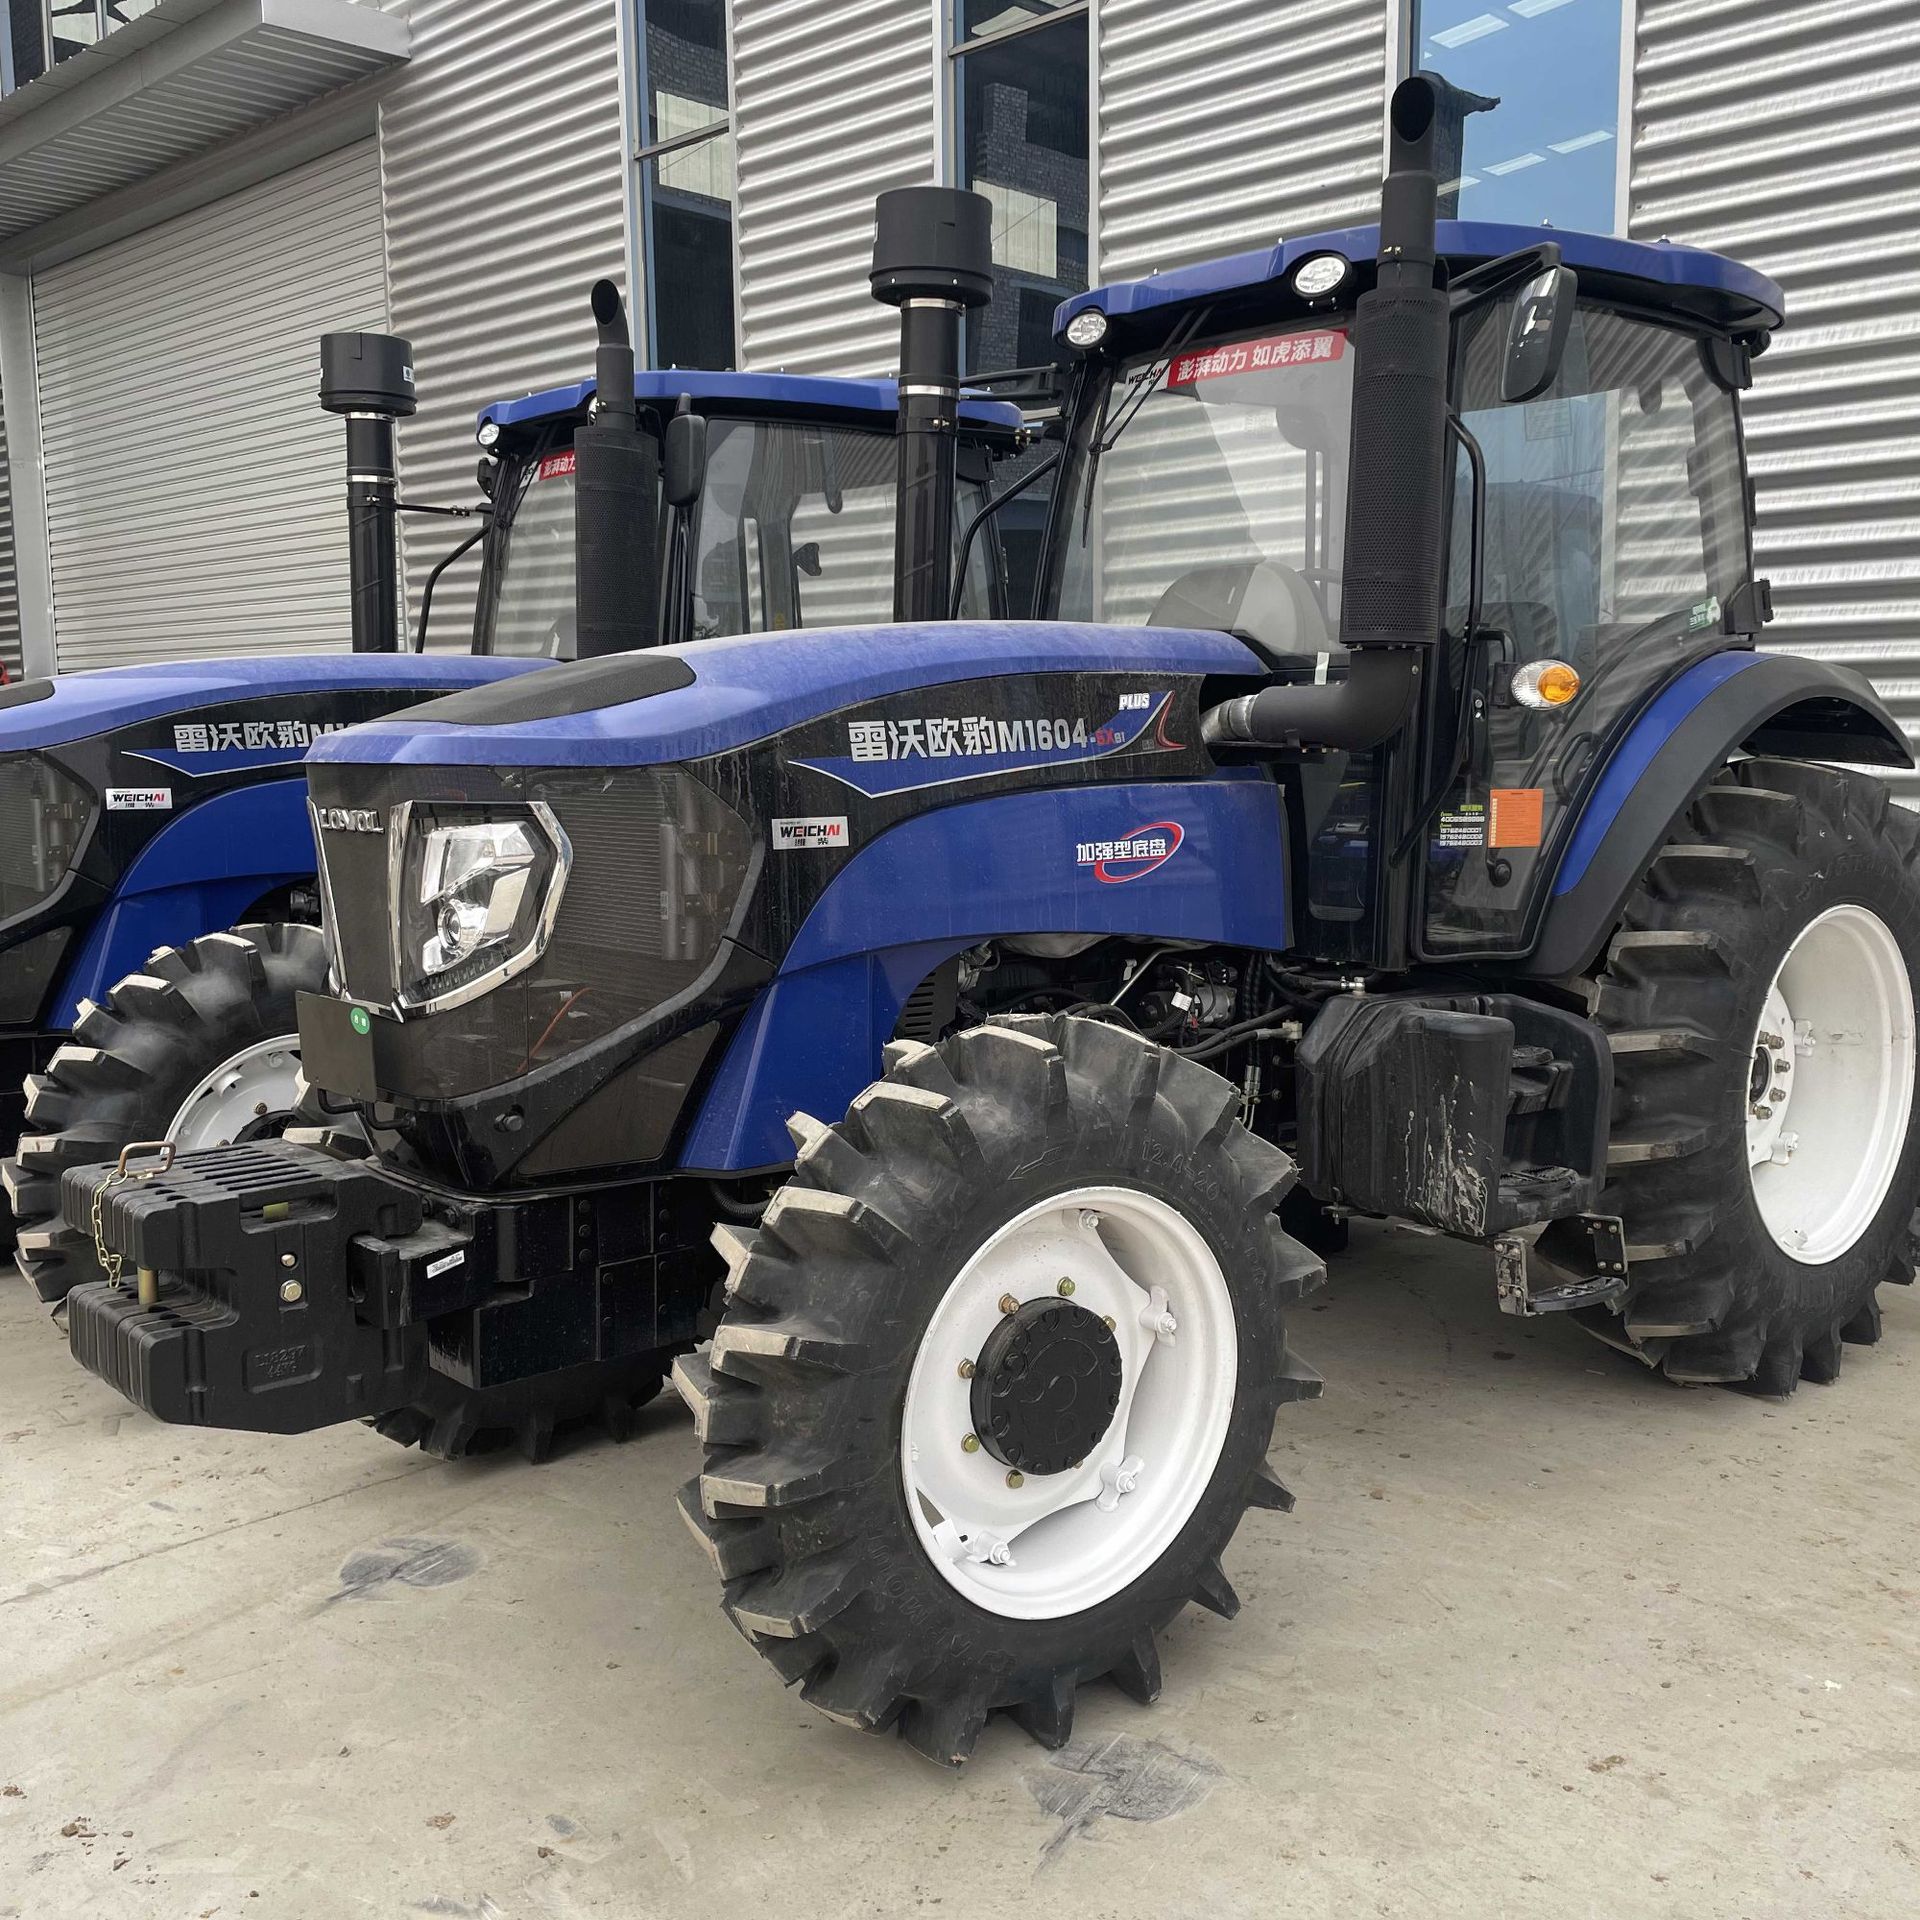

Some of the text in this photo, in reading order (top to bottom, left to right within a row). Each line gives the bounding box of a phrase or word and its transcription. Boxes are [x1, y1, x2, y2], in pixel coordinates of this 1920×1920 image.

[1177, 336, 1334, 382] 澎湃动力 如虎添翼
[1118, 692, 1151, 711] PLUS
[112, 793, 165, 802] WEICHAI
[318, 807, 385, 833] LOVOL
[780, 824, 840, 838] WEICHAI
[1076, 838, 1167, 862] 加强型底盘
